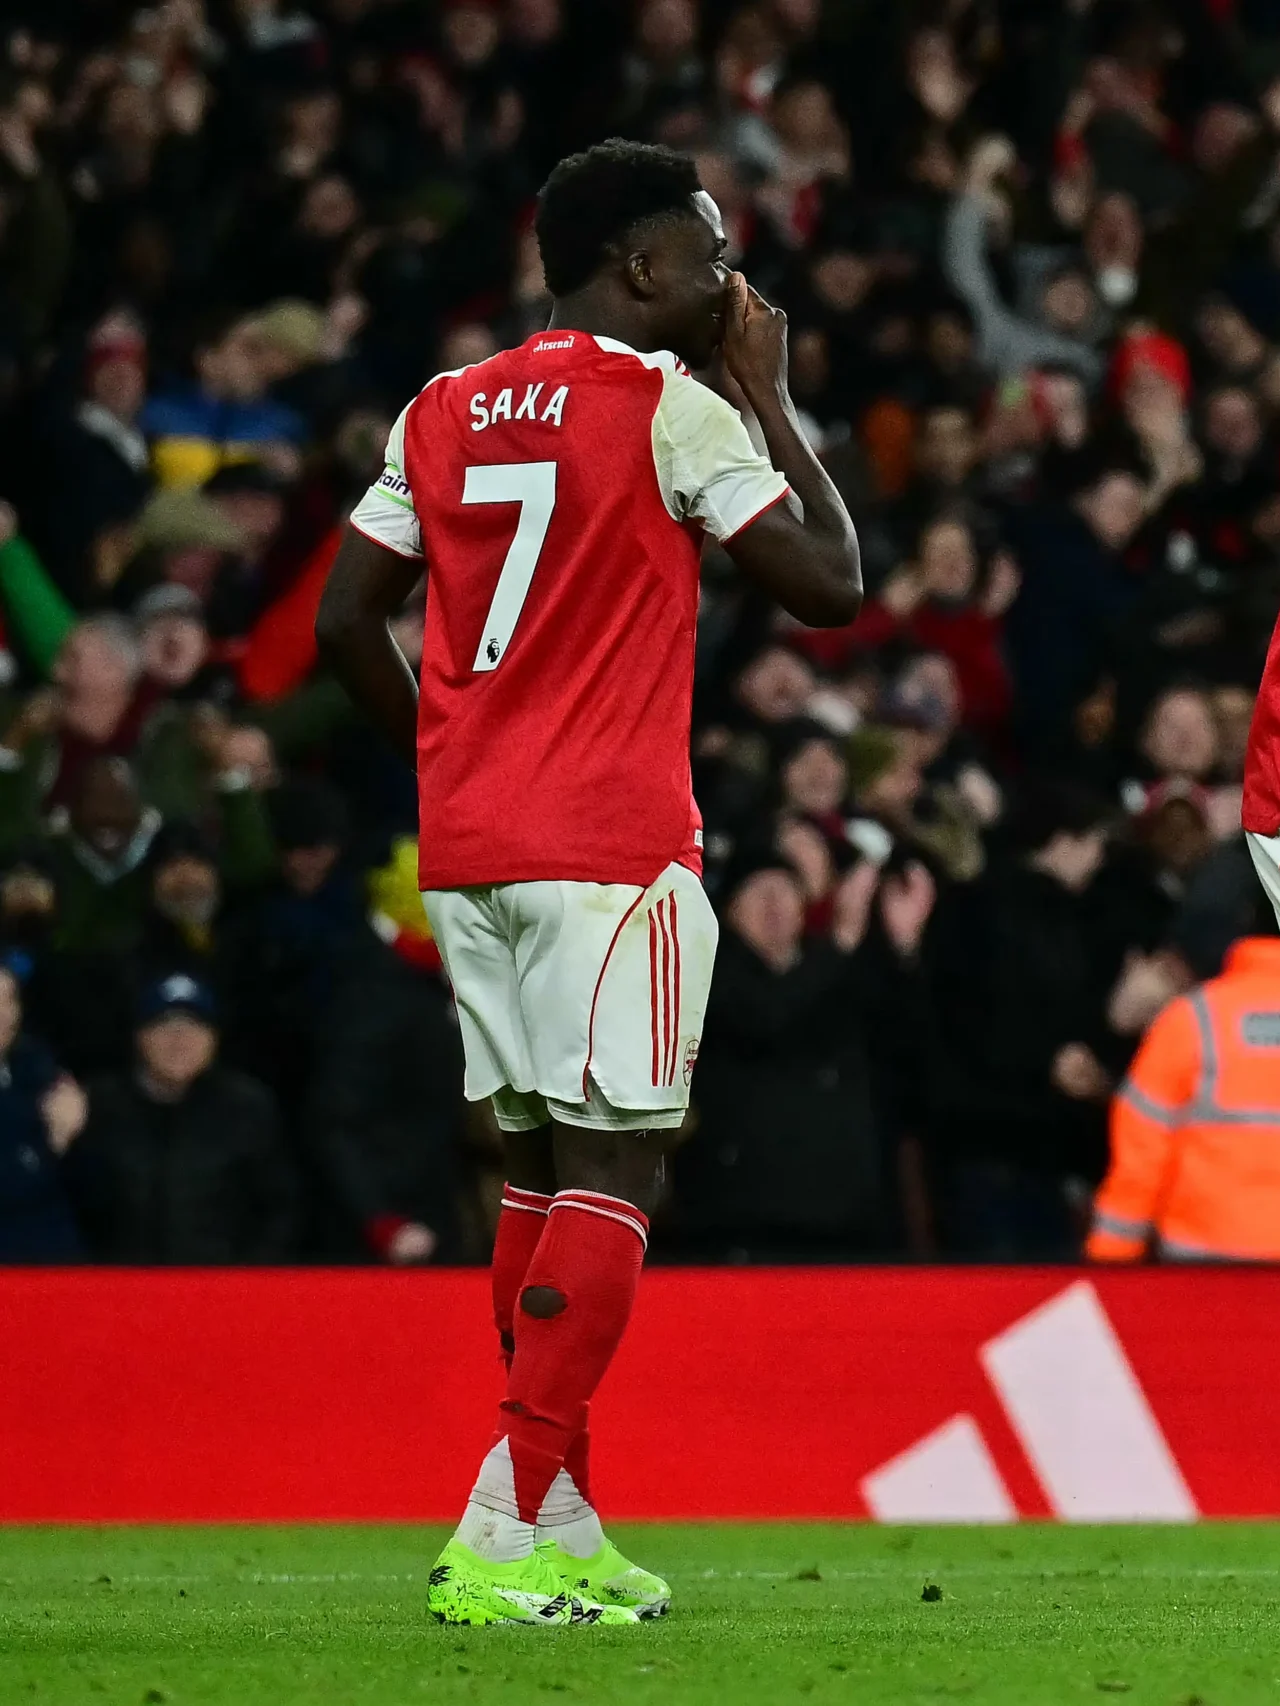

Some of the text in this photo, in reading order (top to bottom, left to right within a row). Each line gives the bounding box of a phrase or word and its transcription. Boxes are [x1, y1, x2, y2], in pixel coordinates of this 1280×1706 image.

[533, 335, 575, 353] Arsenal
[470, 382, 569, 432] SAKA
[461, 461, 557, 672] 7
